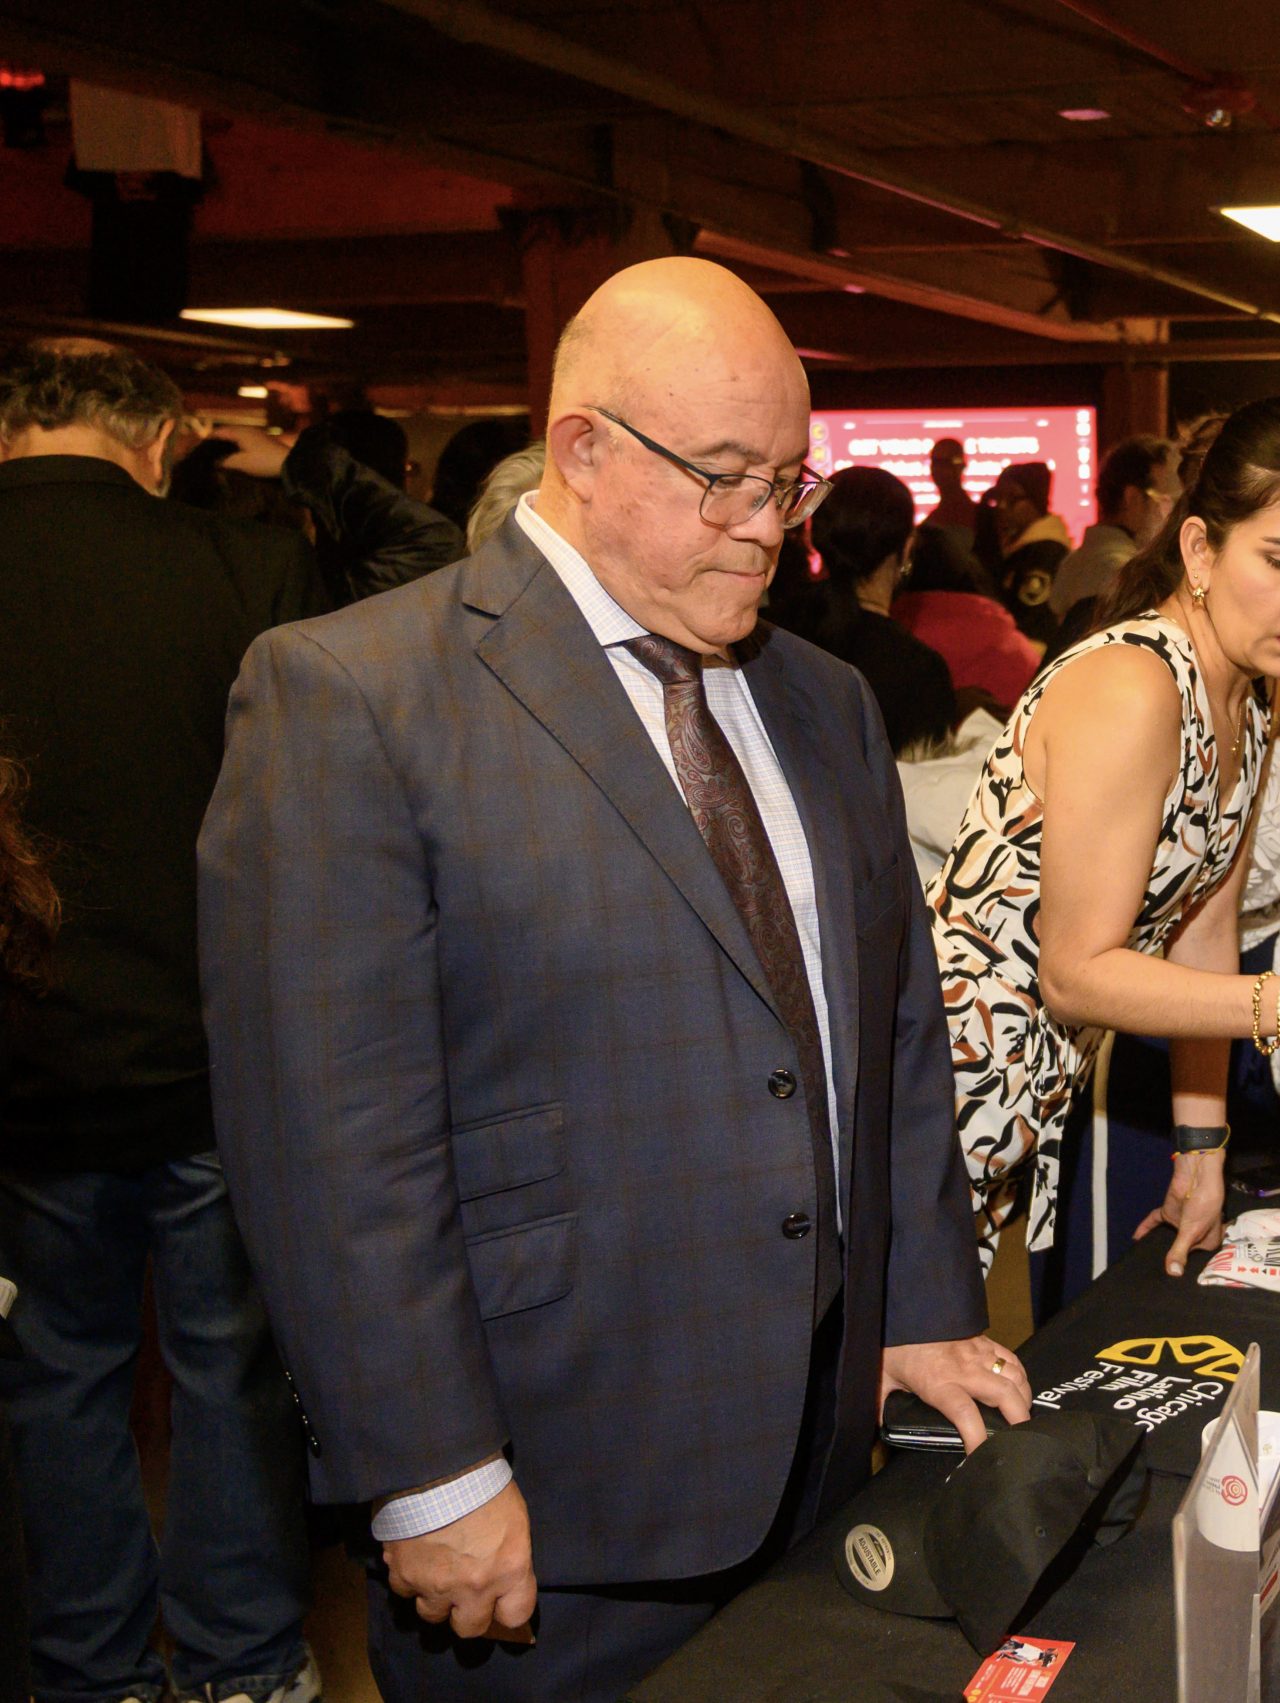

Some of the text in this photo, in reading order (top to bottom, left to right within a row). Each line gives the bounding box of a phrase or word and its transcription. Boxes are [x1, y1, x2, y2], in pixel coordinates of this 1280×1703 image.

[1032, 1361, 1125, 1409] Festival
[1097, 1369, 1159, 1391] Film
[1113, 1376, 1192, 1410] Latino
[859, 1537, 881, 1576] ADJUSTABLE
